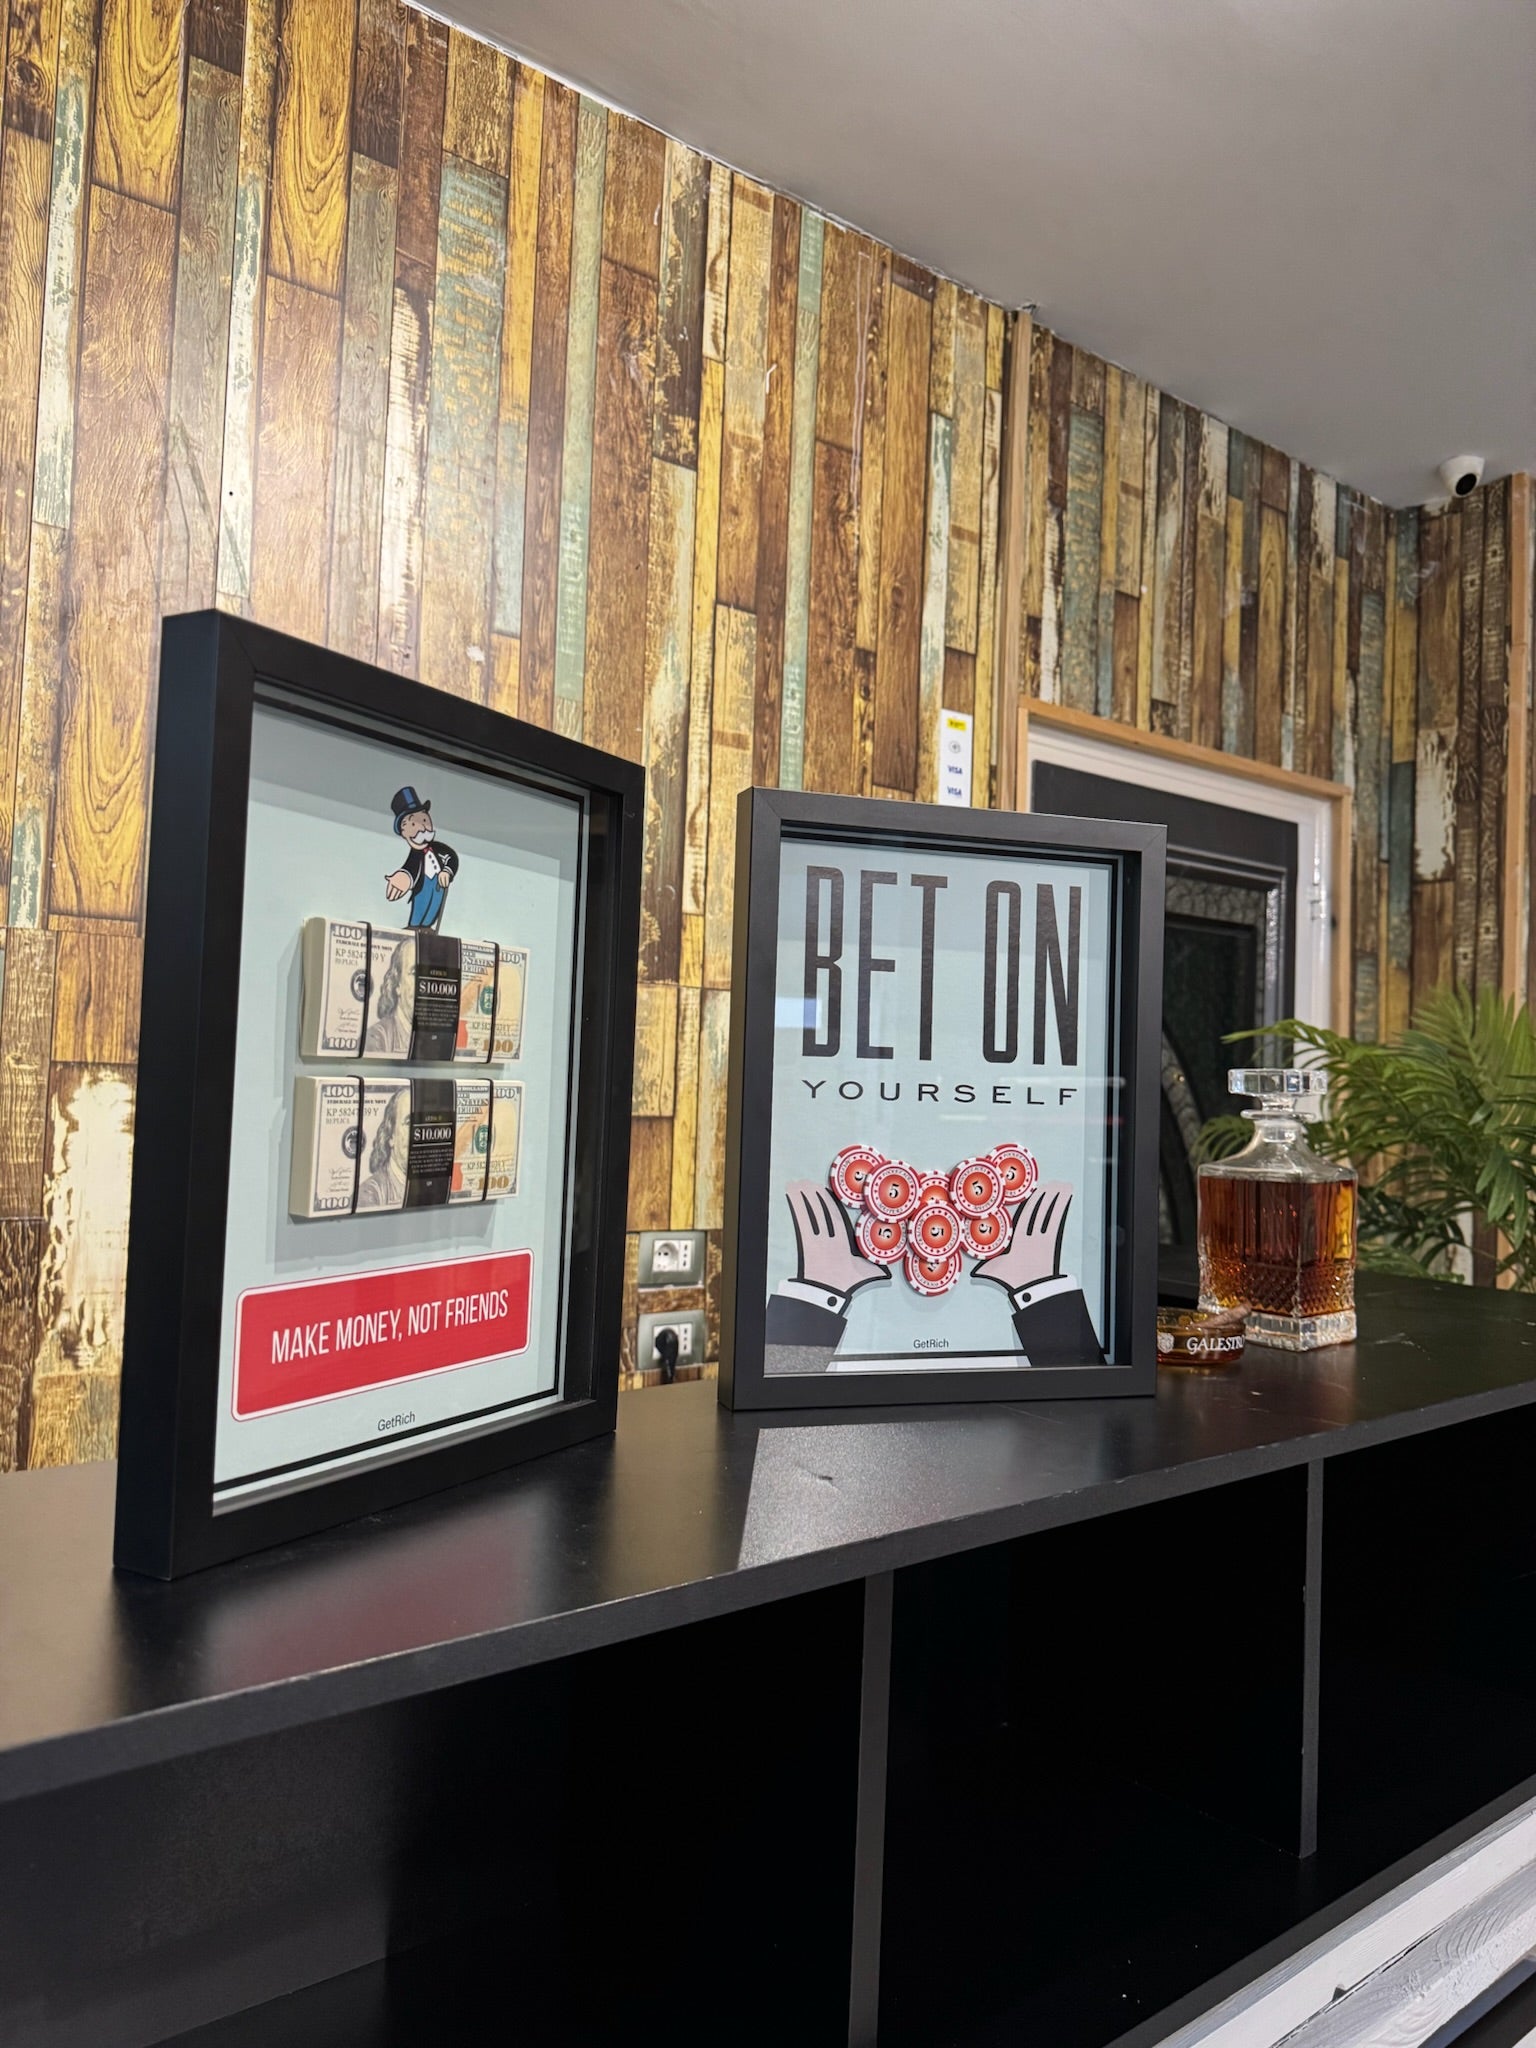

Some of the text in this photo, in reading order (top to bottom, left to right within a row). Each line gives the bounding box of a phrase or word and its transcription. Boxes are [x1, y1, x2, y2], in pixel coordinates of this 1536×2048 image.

[947, 765, 963, 775] VISA
[947, 786, 962, 797] VISA
[333, 924, 362, 940] 100
[802, 865, 1081, 1066] BET ON
[419, 981, 457, 995] $10.000
[328, 1037, 357, 1050] 100
[324, 1085, 355, 1098] 100
[801, 1079, 1077, 1106] YOURSELF
[338, 1107, 371, 1117] 5824739
[414, 1127, 451, 1141] $10.000
[1006, 1166, 1017, 1181] 5
[889, 1183, 899, 1199] 5
[972, 1180, 983, 1196] 5
[320, 1196, 350, 1209] 100
[878, 1228, 892, 1239] 5
[930, 1226, 944, 1237] 5
[979, 1223, 992, 1234] 5
[272, 1289, 509, 1364] MAKE MONEY, NOT FRIENDS
[913, 1338, 949, 1349] GetRich
[377, 1411, 416, 1432] GetRich
